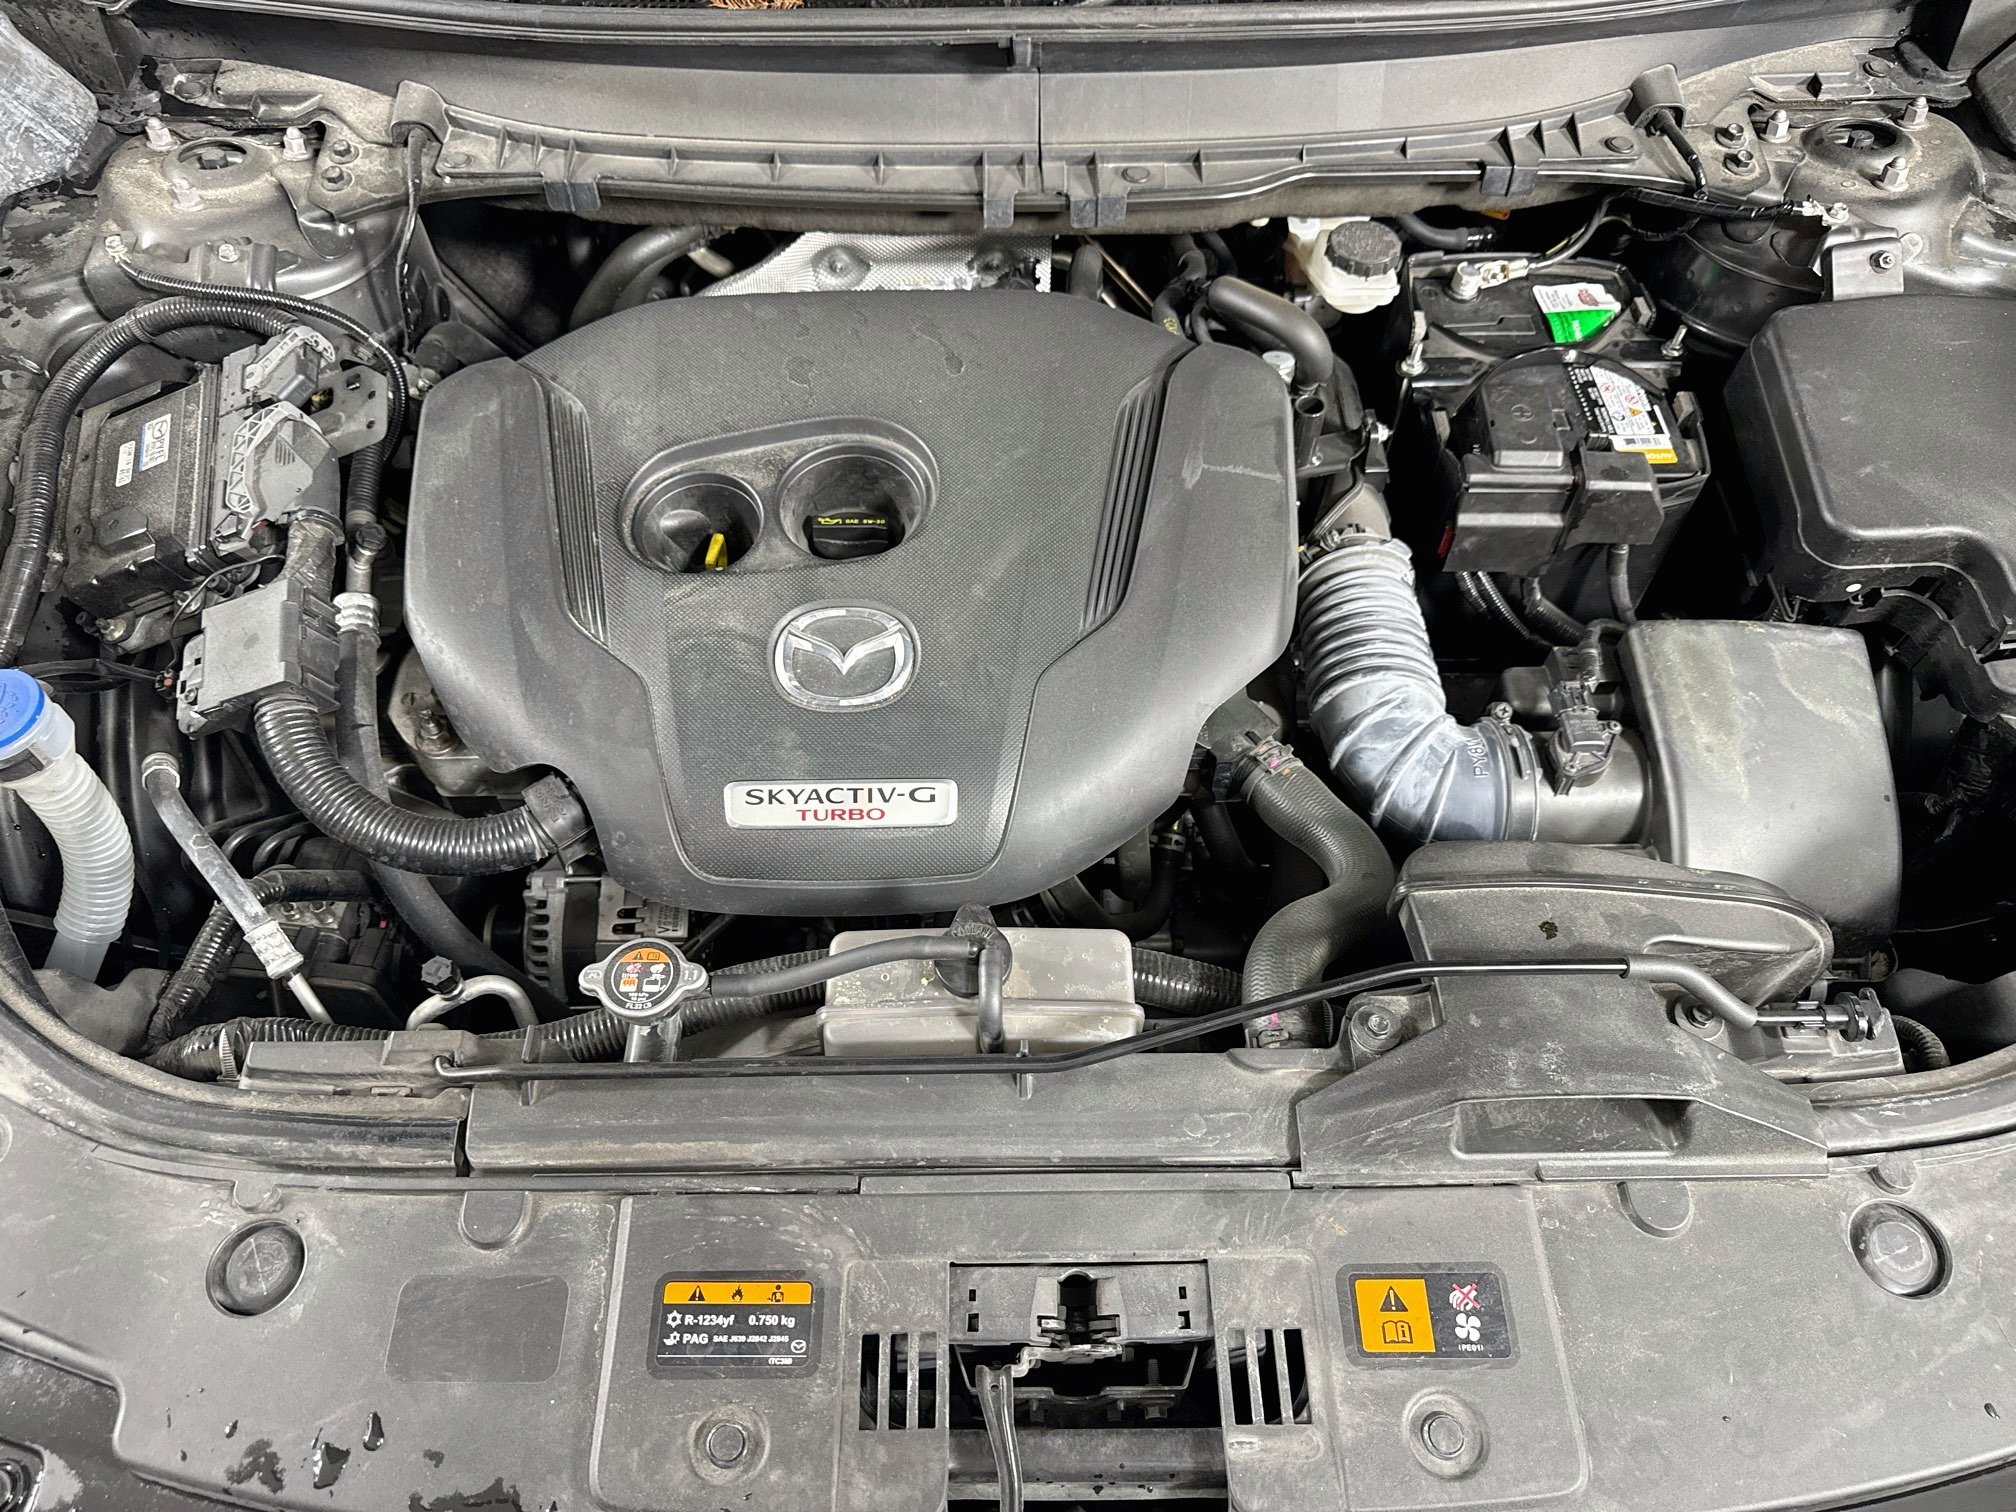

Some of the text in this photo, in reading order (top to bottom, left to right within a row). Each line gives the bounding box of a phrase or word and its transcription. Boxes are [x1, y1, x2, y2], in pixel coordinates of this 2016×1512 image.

[745, 786, 936, 806] SKYACTIV-G
[796, 807, 886, 822] TURBO
[683, 969, 698, 980] 1.1
[625, 1002, 643, 1010] FL22
[684, 1314, 796, 1328] R-1234yf 0.750 kg
[682, 1333, 708, 1344] PAG
[713, 1335, 728, 1343] SAE
